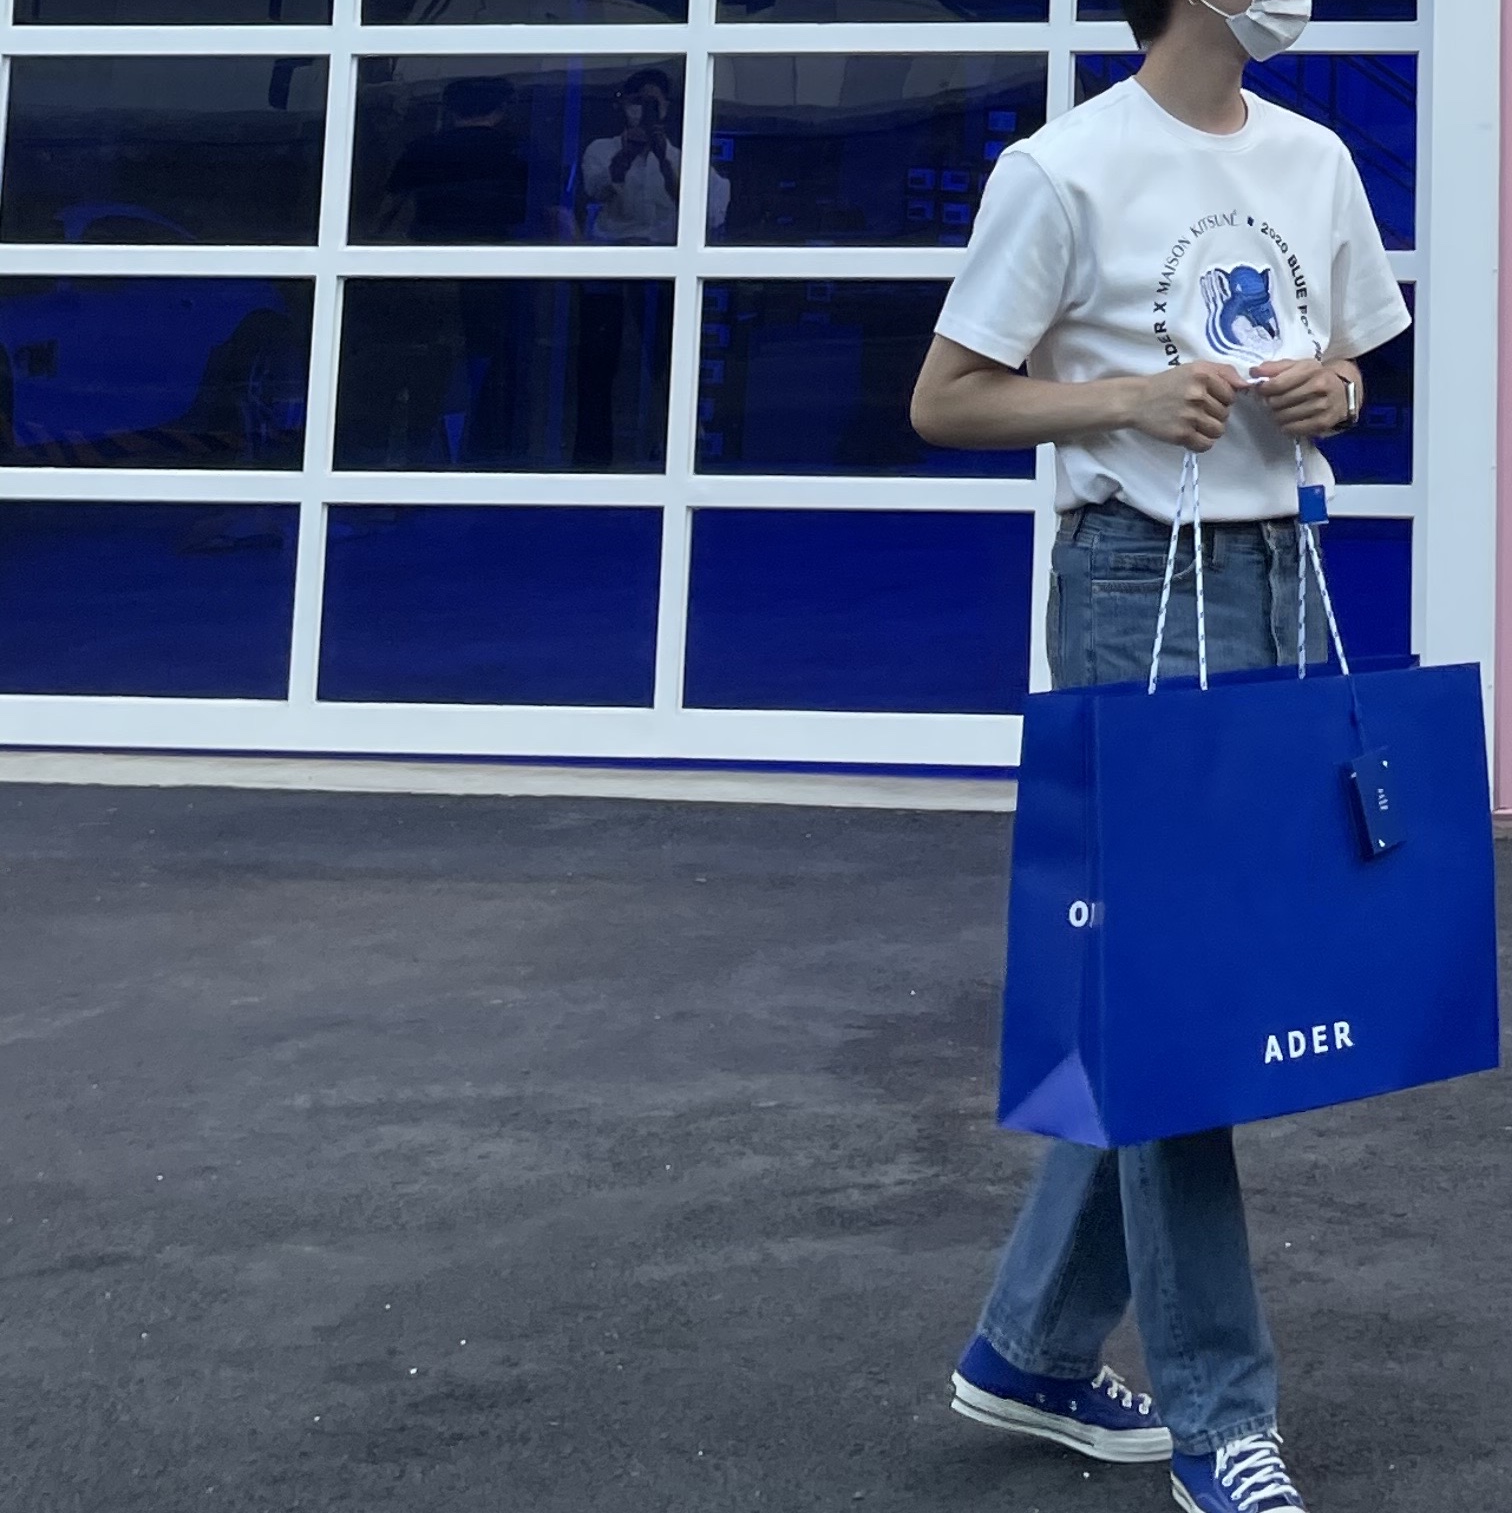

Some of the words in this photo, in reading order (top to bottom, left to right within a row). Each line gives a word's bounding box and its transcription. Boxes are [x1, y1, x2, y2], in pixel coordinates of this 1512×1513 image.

[1260, 222, 1289, 254] 2020
[1156, 236, 1191, 295] MAISON
[1287, 254, 1308, 300] BLUE
[1153, 301, 1167, 313] X
[1154, 320, 1181, 367] ADER
[1264, 1021, 1354, 1064] ADER
